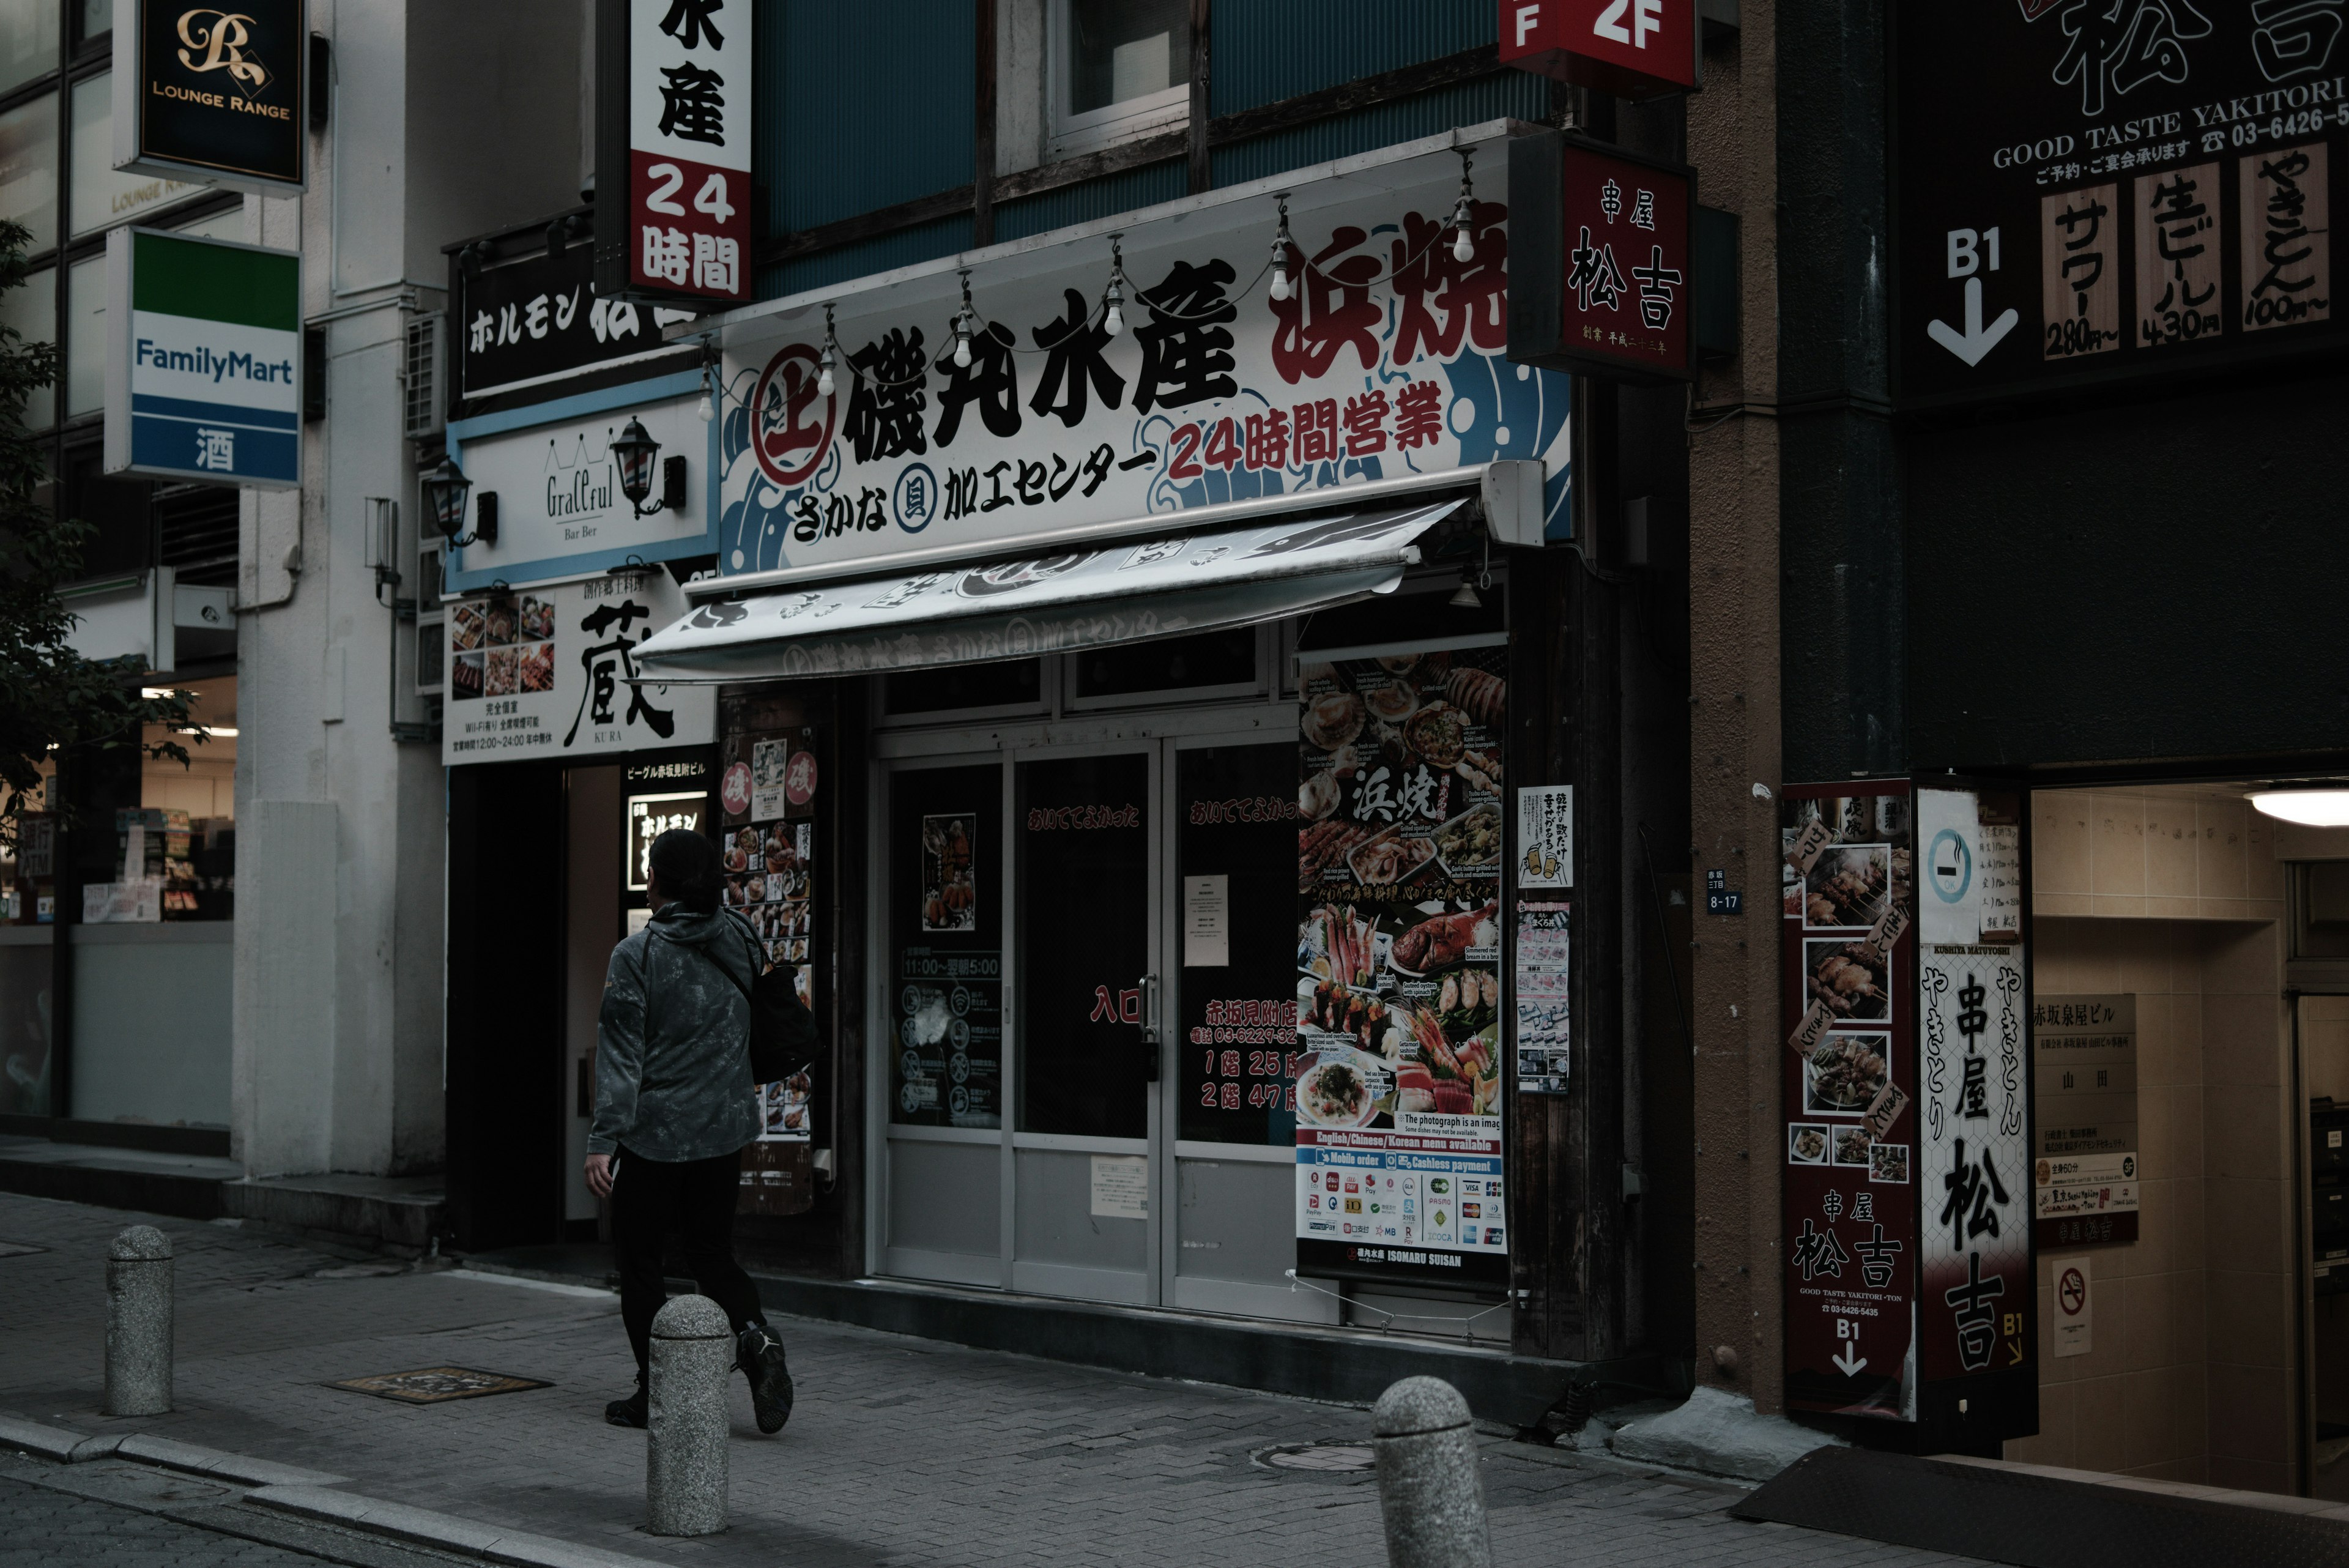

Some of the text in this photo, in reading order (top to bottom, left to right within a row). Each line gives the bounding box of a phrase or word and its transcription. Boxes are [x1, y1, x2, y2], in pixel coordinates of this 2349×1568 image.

[153, 80, 291, 121] LOUNGE RANGE
[1993, 76, 2346, 169] GOOD TASTE YAKITORI
[2036, 139, 2191, 185] ご予約・ご宴会承ります
[1601, 177, 1655, 231] 串屋
[1948, 226, 2000, 279] B1
[2055, 199, 2107, 316] サワー
[2151, 174, 2216, 313] 生ビール
[642, 225, 740, 295] 時間
[1568, 225, 1682, 331] 松吉
[470, 283, 579, 353] ホルモン
[2142, 310, 2221, 346] 430円
[136, 338, 292, 385] FamilyMart
[842, 259, 1238, 464] 磯丸水産
[1168, 380, 1442, 480] 24時間営業
[196, 427, 234, 472] 酒
[795, 444, 1157, 542] さかな 加工センター
[564, 526, 597, 540] Bar Ber
[563, 600, 674, 747] 蔵
[486, 700, 518, 716] 完全個室
[628, 762, 705, 780] ビーグル赤坂見附ビル
[1353, 764, 1438, 822] 浜焼
[1028, 803, 1139, 831] あいててよかった
[1190, 796, 1299, 825] あいててよかっ
[1801, 827, 1826, 860] サワー
[1708, 870, 1723, 880] 赤坂
[1708, 881, 1724, 890] 三丁目
[1944, 880, 1956, 890] OK
[1711, 896, 1736, 908] 8-17
[1934, 946, 2010, 956] KUSHIYA MATUYOSHI
[1091, 984, 1140, 1024] 入口
[1206, 1000, 1297, 1026] 赤坂見附店
[2033, 1003, 2115, 1027] 赤坂泉屋ビル
[1190, 1027, 1212, 1044] 電話
[1921, 966, 1949, 1141] やきとり
[1997, 966, 2022, 1135] やきとん
[1406, 1114, 1418, 1124] The
[1419, 1115, 1460, 1128] photograph
[1462, 1116, 1469, 1126] is
[1422, 1138, 1447, 1149] menu
[1449, 1139, 1491, 1151] available
[1330, 1151, 1491, 1174] Mobile order Cashless payment
[2124, 1163, 2134, 1173] 3F
[1346, 1200, 1360, 1210] iD
[1824, 1189, 1874, 1222] 串屋
[1428, 1233, 1452, 1241] ICOCA
[2059, 1216, 2112, 1243] 串屋 松吉
[1387, 1250, 1426, 1265] ISOMARU
[1429, 1252, 1461, 1267] SUISAN
[1793, 1219, 1902, 1287] 松吉
[1847, 1291, 1882, 1300] YAKITORI
[1831, 1306, 1879, 1317] 03-6426-5435
[2004, 1313, 2022, 1336] B1
[1836, 1318, 1859, 1340] B1
